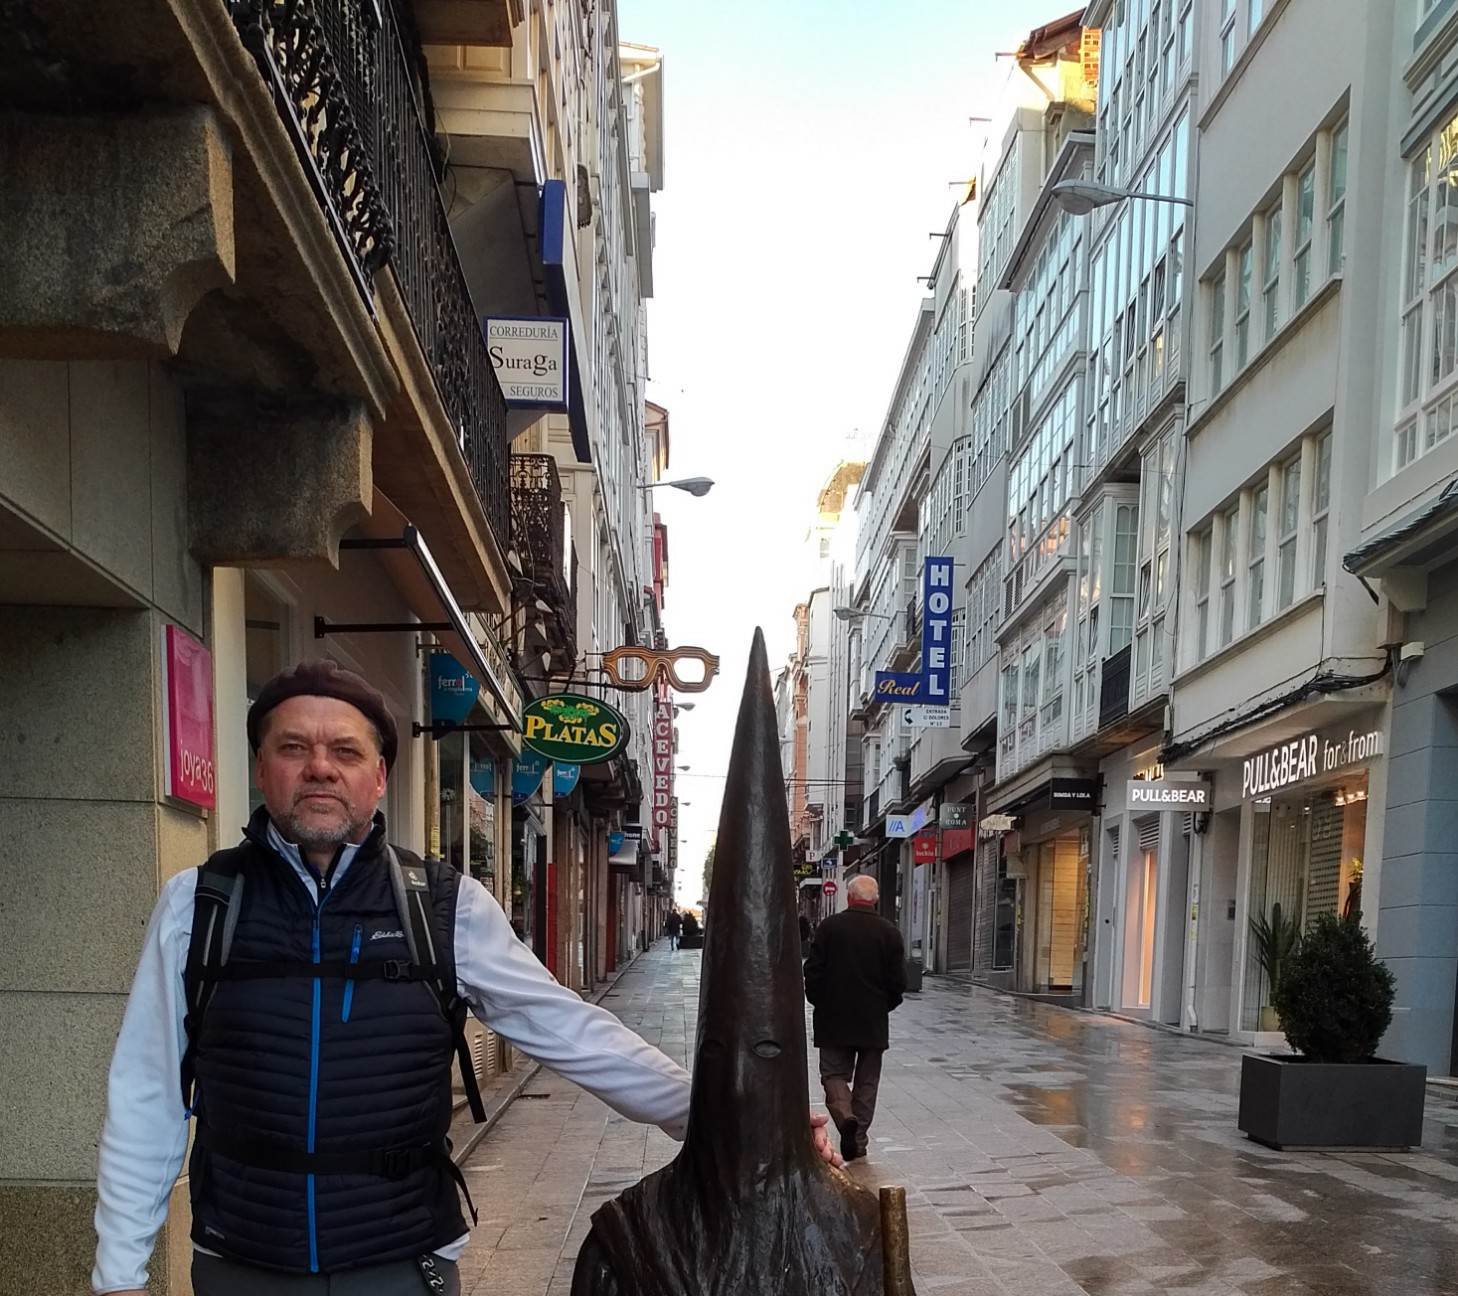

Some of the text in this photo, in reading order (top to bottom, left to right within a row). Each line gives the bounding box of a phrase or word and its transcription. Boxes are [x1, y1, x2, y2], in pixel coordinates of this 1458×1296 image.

[489, 325, 559, 339] CORREDURÍA
[489, 345, 557, 377] Suraga
[509, 385, 559, 398] SEGUROS
[928, 564, 950, 696] HOTEL
[877, 679, 921, 697] Real
[525, 714, 617, 748] PLATAS
[179, 739, 214, 794] joya36
[655, 703, 671, 824] ACEVEDO
[1242, 734, 1318, 798] PULL&BEAR
[1132, 788, 1205, 803] PULL&BEAR
